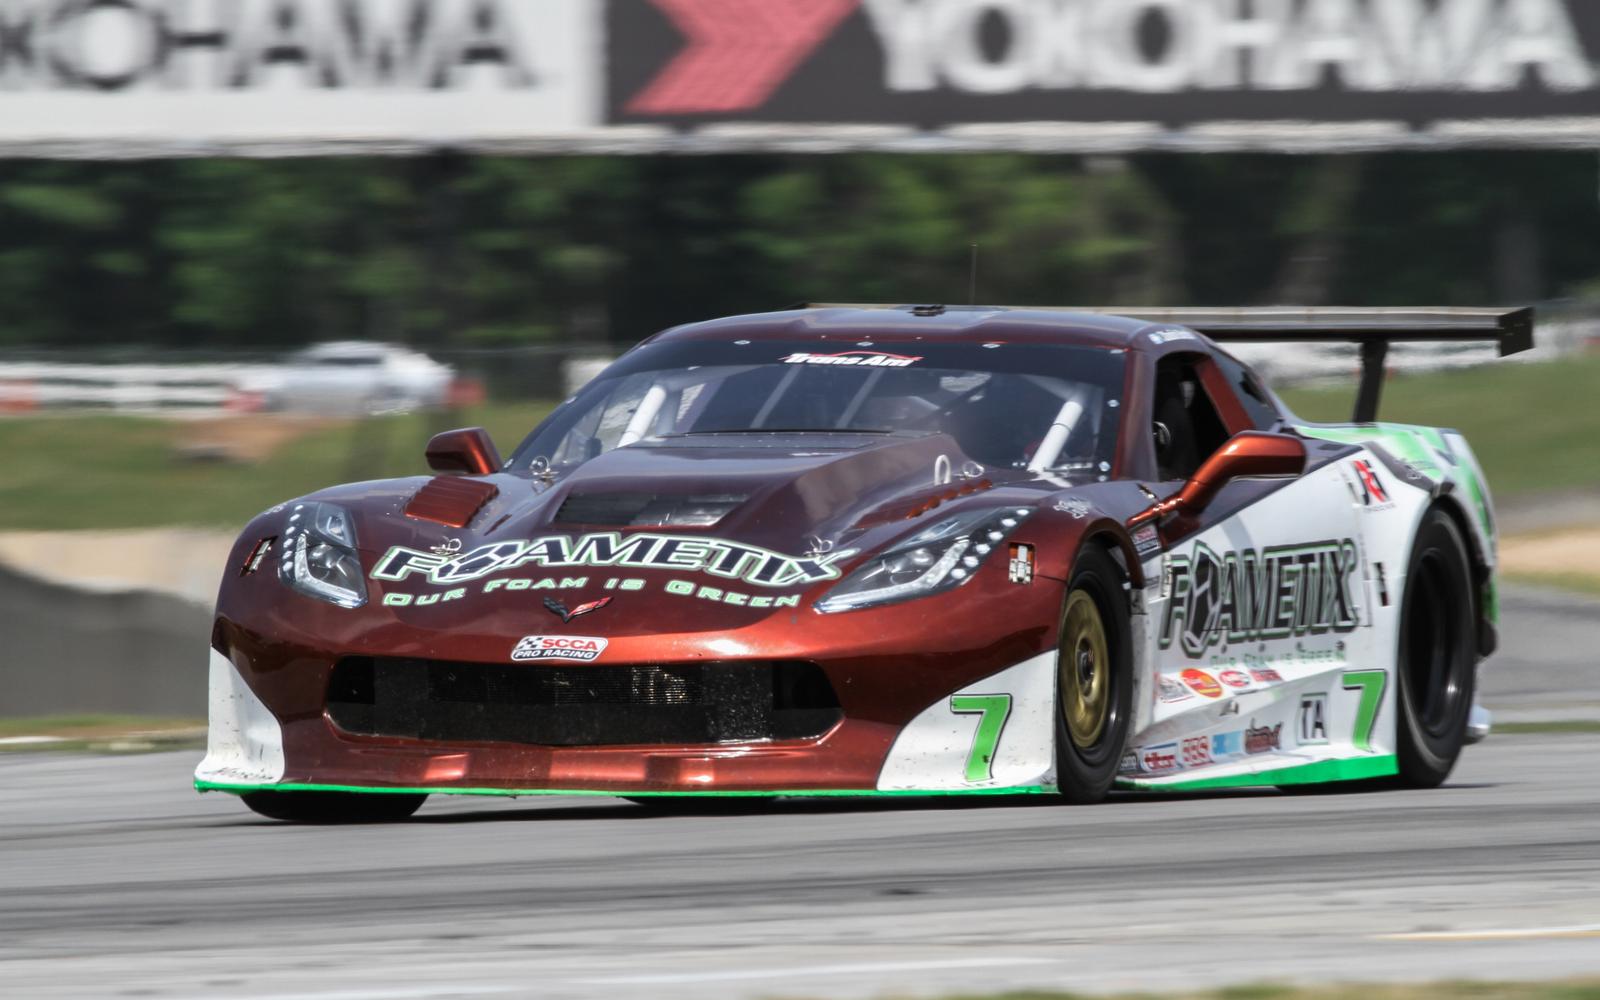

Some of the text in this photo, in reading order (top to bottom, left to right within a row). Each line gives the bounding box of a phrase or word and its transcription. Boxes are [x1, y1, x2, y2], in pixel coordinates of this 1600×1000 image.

[866, 0, 1596, 93] YOKOHAMA
[784, 353, 915, 367] Trans Am
[370, 531, 860, 587] FOAMETIX
[382, 576, 801, 607] OUR FOAM IS GREEN
[1158, 537, 1360, 658] FOAMETIX
[514, 649, 595, 659] PRO RACING
[542, 638, 598, 650] SCCA
[1300, 700, 1327, 739] TA
[1342, 669, 1388, 753] 7
[950, 693, 1012, 782] 7
